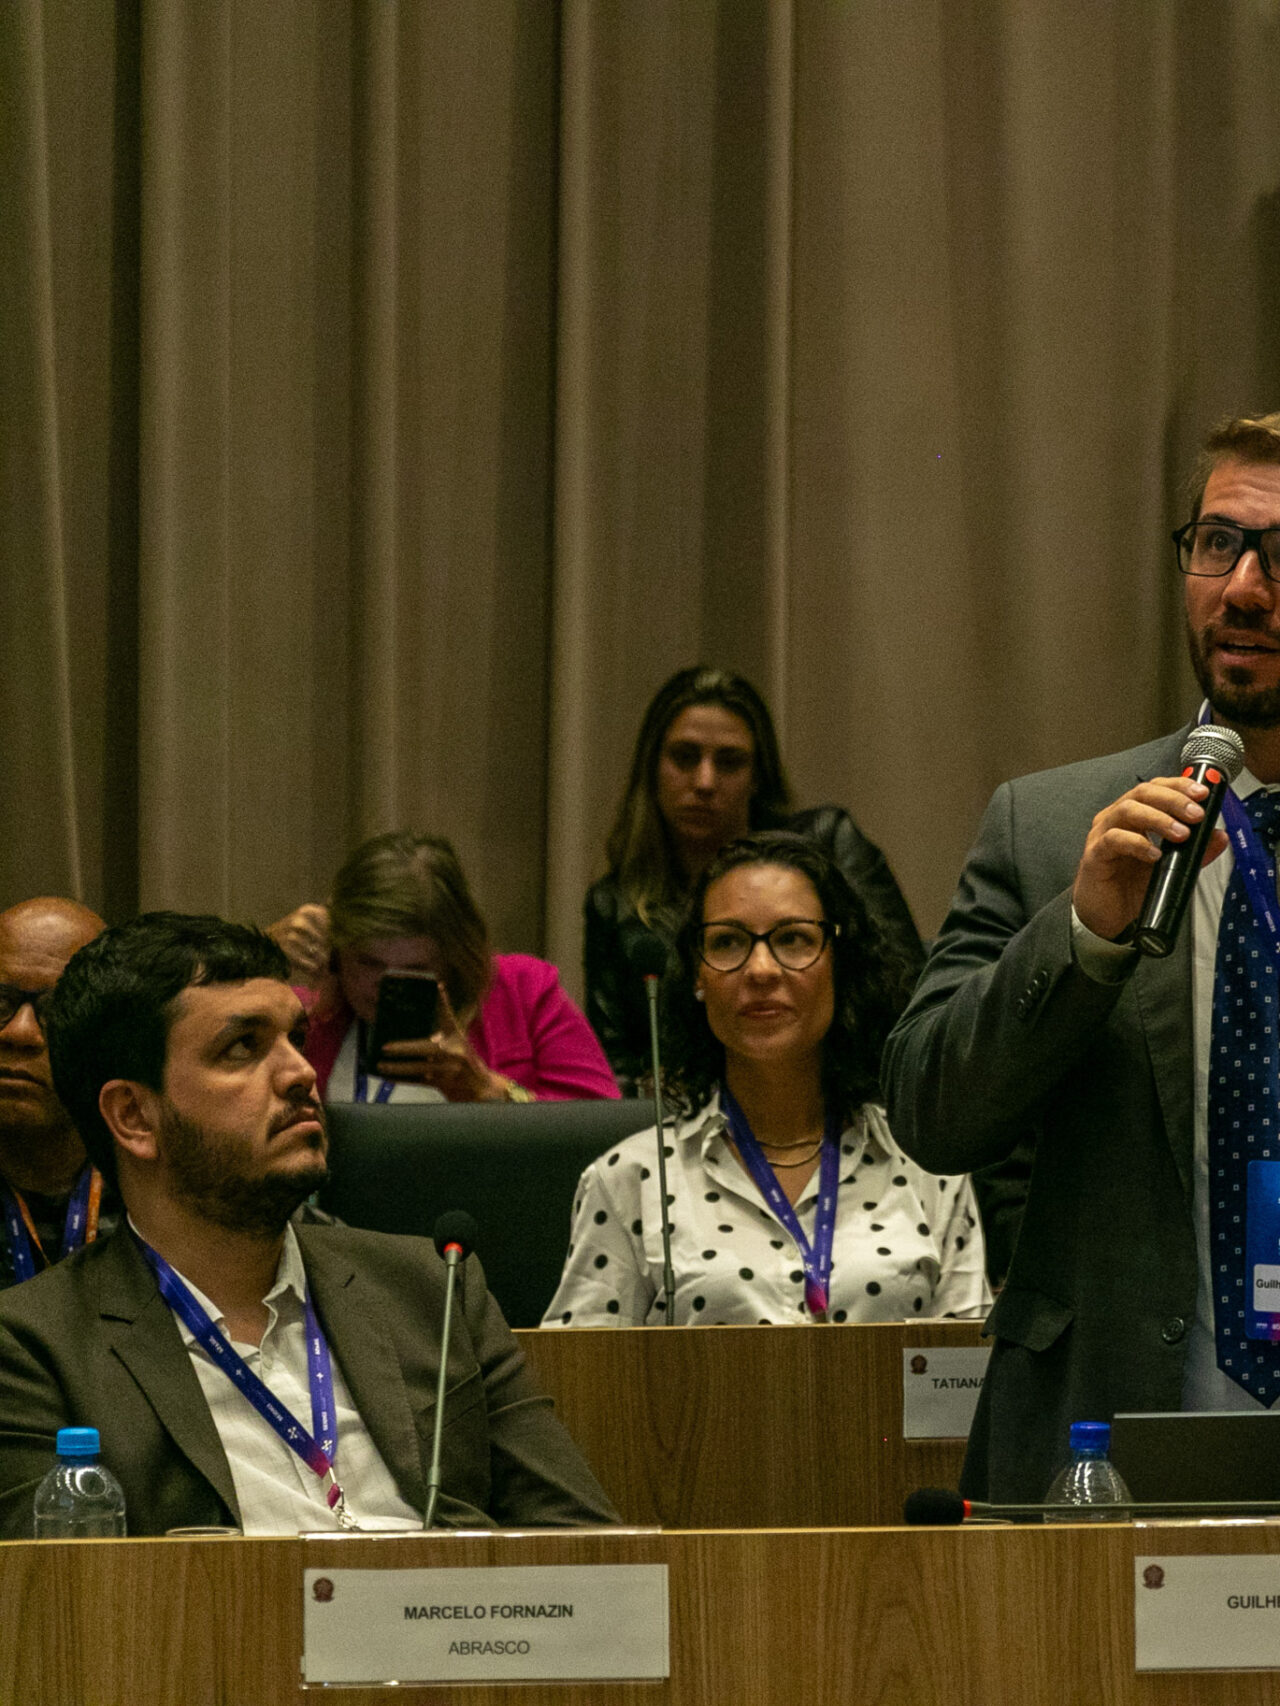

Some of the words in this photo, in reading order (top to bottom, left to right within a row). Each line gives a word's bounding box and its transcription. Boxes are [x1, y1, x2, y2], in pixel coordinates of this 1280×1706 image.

[404, 1605, 486, 1620] MARCELO
[490, 1604, 573, 1619] FORNAZIN
[448, 1639, 531, 1655] ABRASCO
